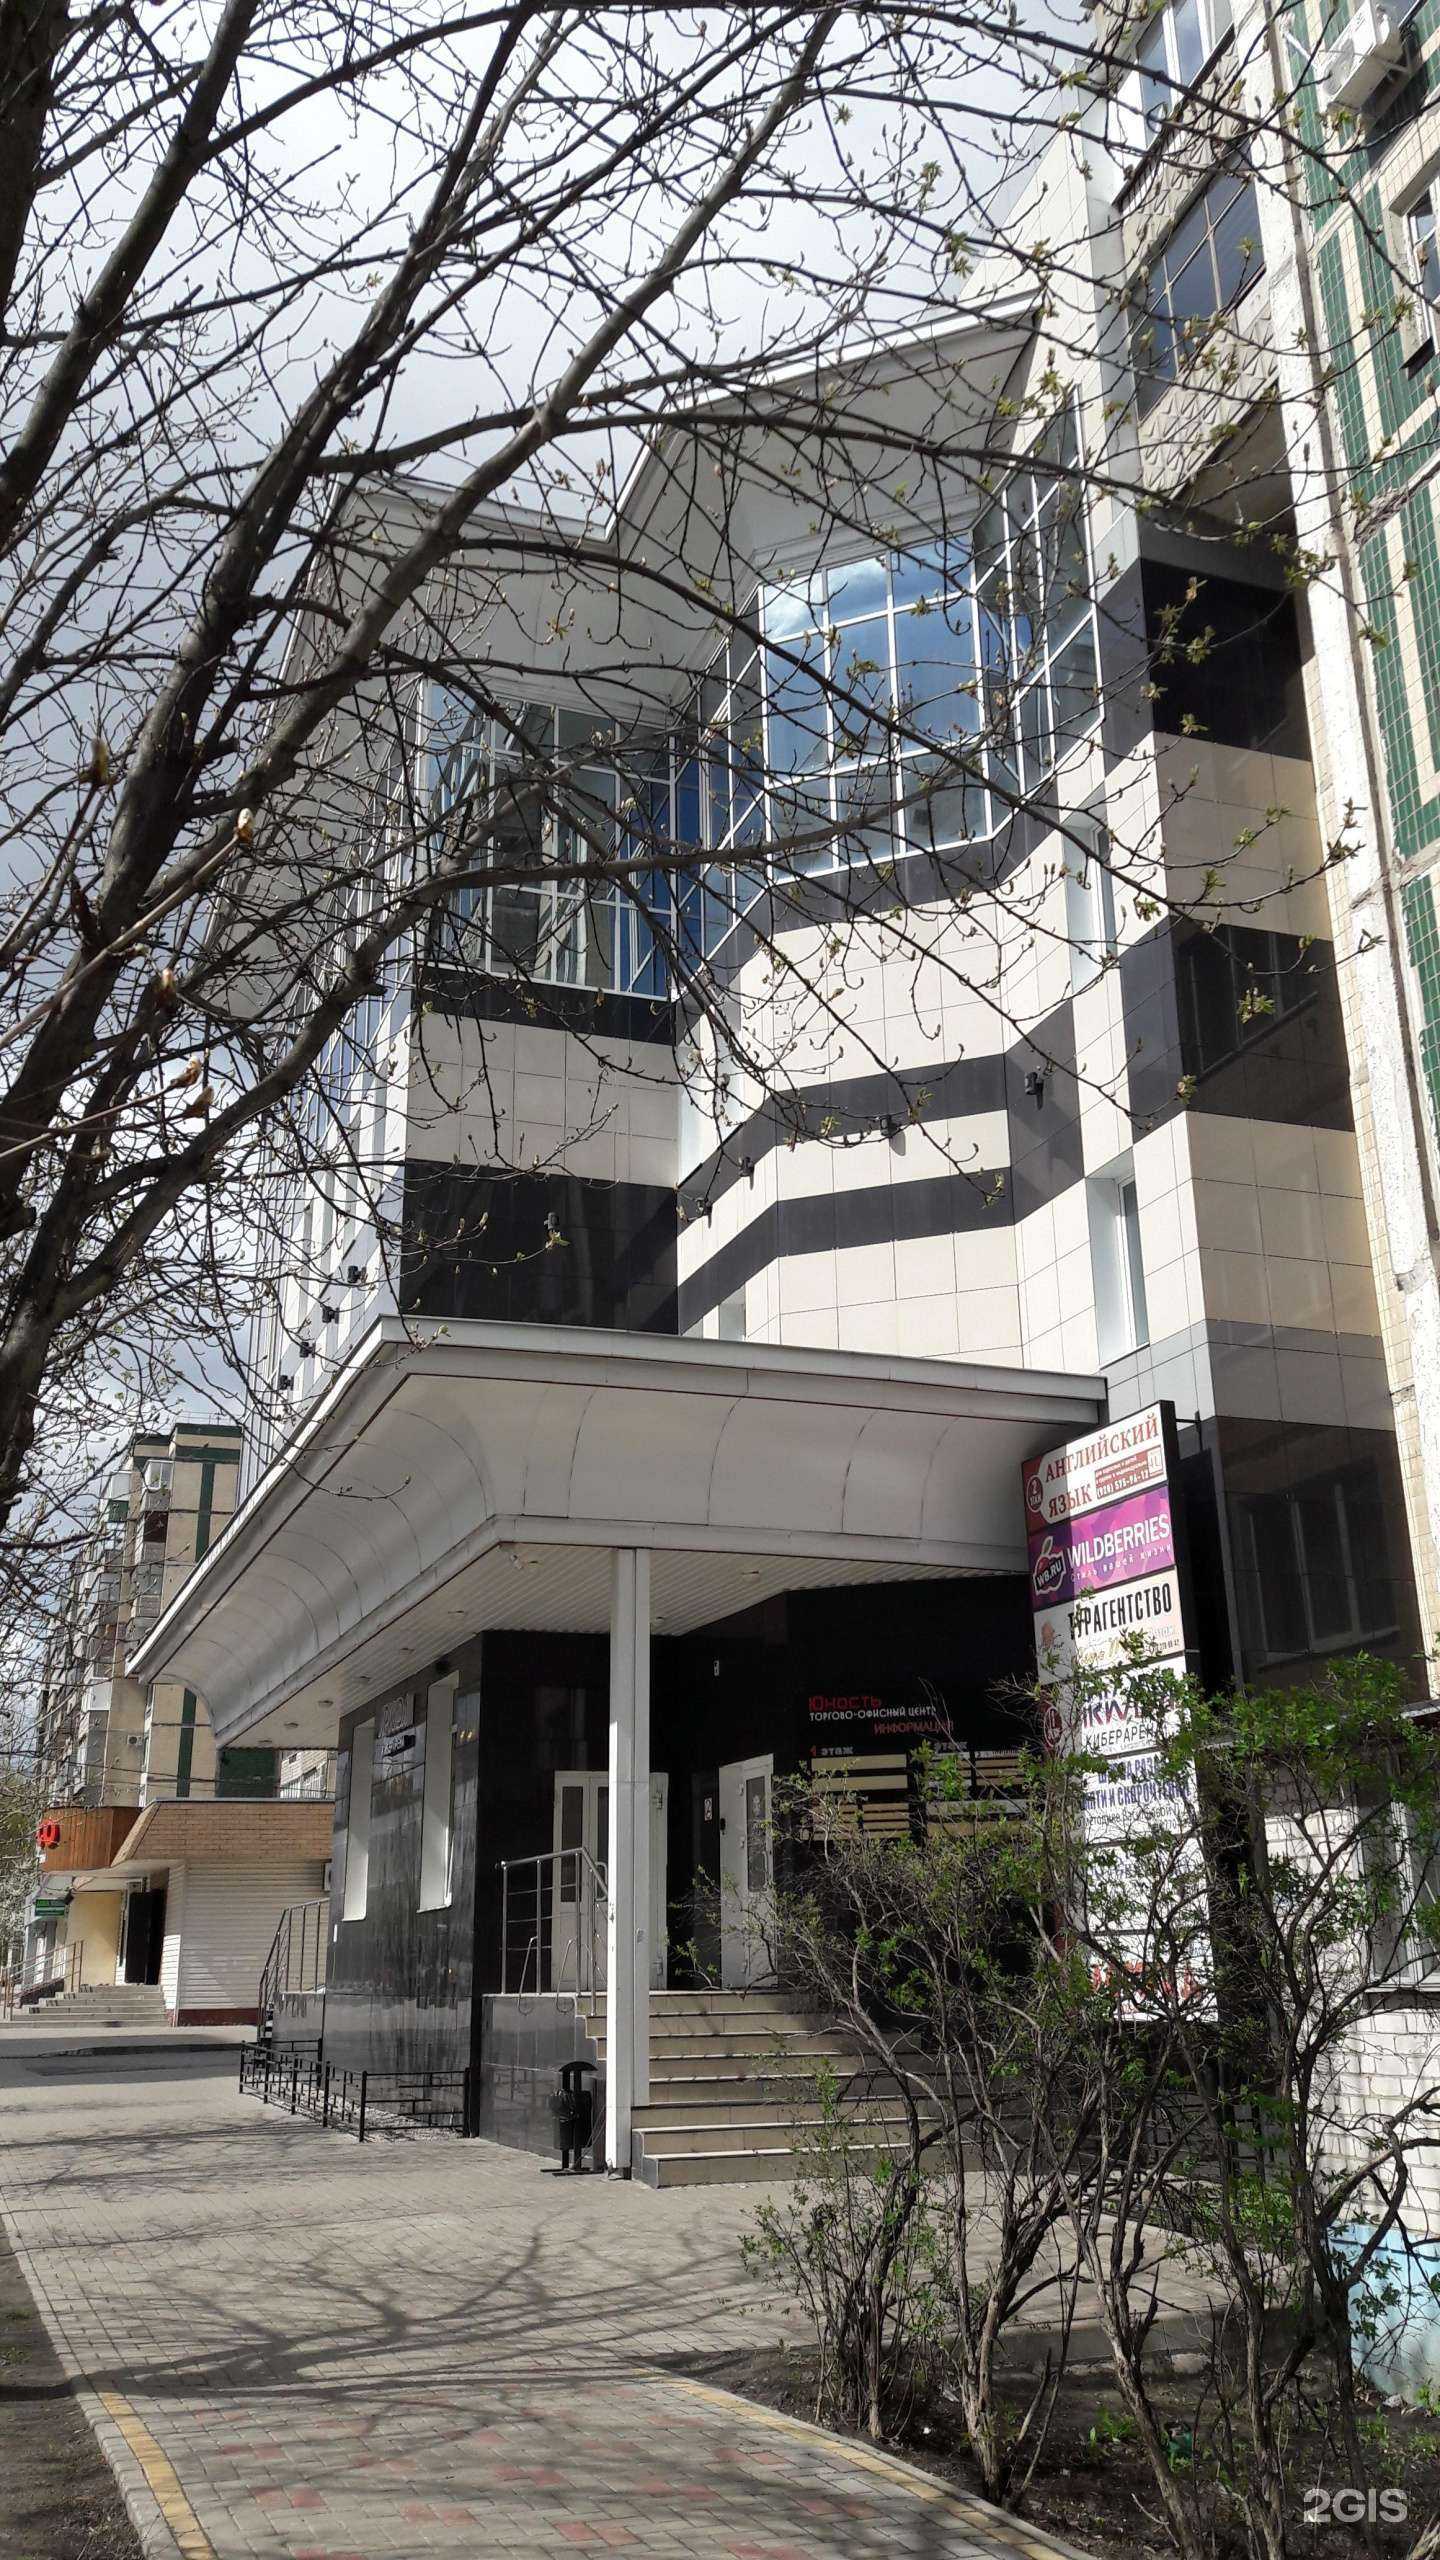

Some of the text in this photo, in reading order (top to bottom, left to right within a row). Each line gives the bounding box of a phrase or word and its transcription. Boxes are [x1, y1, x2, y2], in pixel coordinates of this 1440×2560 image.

[1045, 1412, 1160, 1483] АНГЛИЙСКИЙ
[1048, 1484, 1093, 1518] ЯЗЫК
[1067, 1514, 1171, 1567] WILDBERRIES
[1037, 1561, 1062, 1586] WB.RU
[809, 1705, 906, 1721] ТОРГОВО-ОФИСНЫЙ
